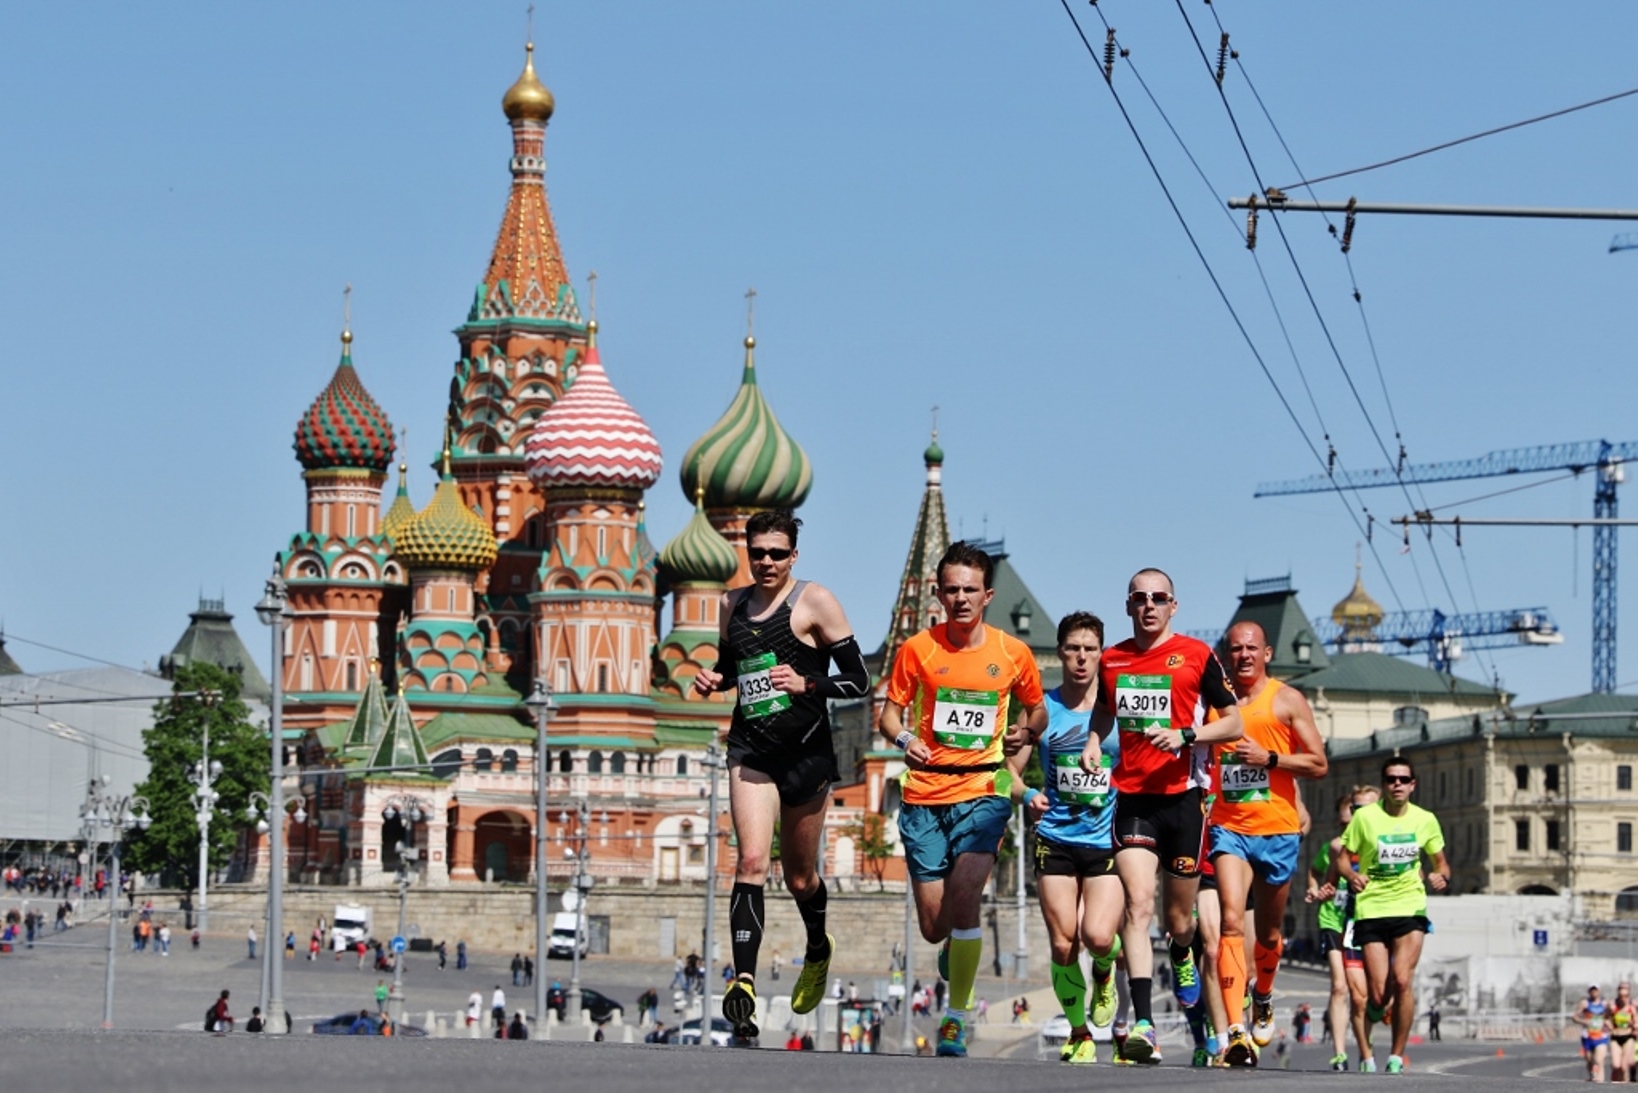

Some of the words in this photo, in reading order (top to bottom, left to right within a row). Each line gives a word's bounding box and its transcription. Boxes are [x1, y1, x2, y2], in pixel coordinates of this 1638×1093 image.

[740, 682, 746, 698] A
[746, 676, 777, 697] 333
[1118, 694, 1129, 710] A
[1131, 695, 1168, 711] 3019
[947, 710, 959, 726] A
[964, 710, 984, 728] 78
[1060, 772, 1070, 786] A
[1073, 773, 1107, 787] 5764
[1223, 770, 1231, 784] A
[1233, 768, 1267, 784] 1526
[1381, 849, 1389, 858] A
